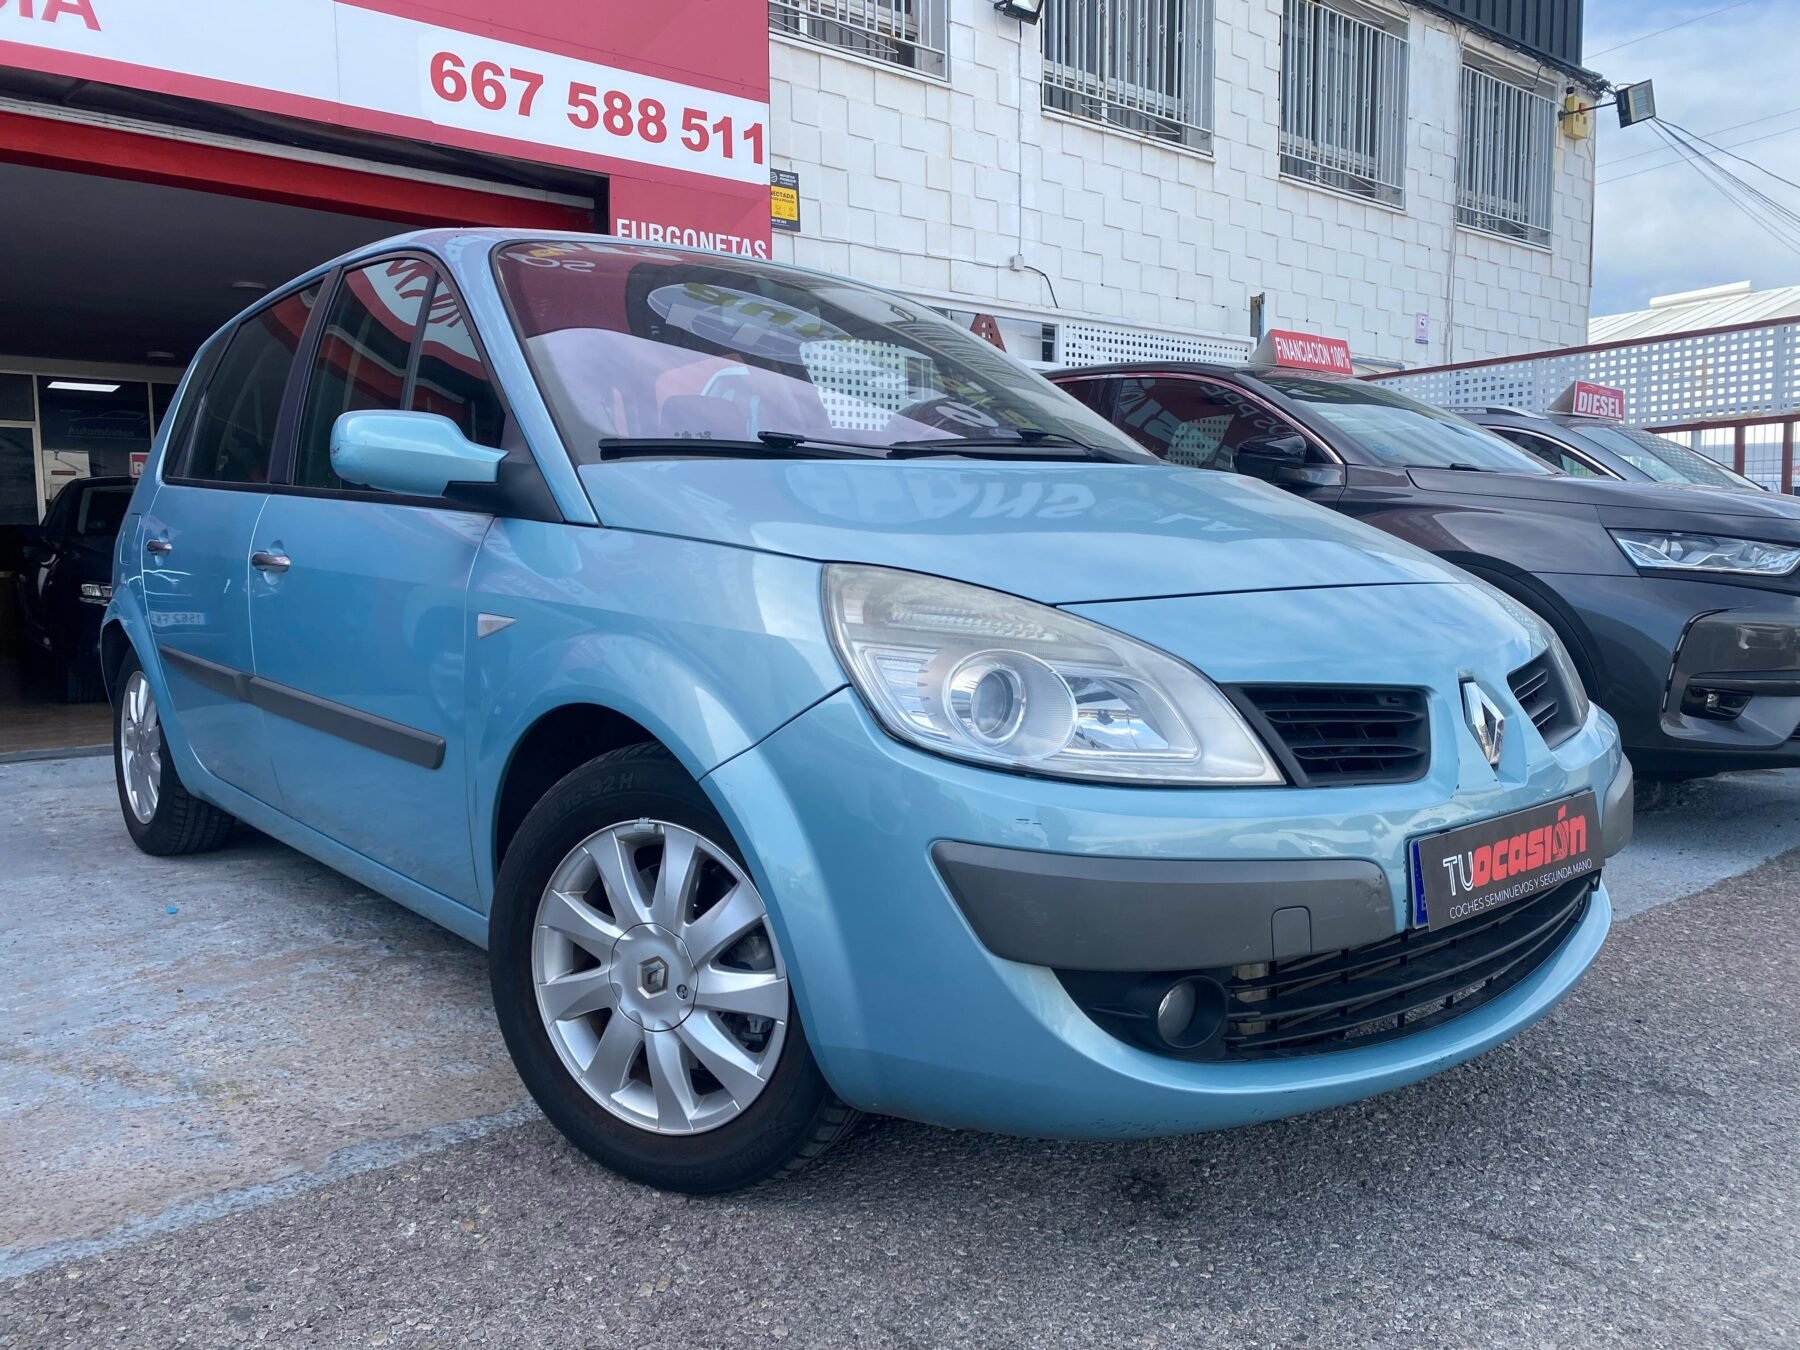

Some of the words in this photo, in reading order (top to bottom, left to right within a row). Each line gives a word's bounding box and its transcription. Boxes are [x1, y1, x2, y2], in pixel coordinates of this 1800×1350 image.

[430, 52, 544, 117] 667
[567, 81, 667, 144] 588
[681, 107, 763, 165] 511
[616, 218, 767, 260] FURGONETAS
[1274, 337, 1332, 366] FINANCIACIÓN
[1330, 345, 1351, 369] 100%
[1577, 391, 1623, 418] DIESEL
[1449, 896, 1485, 920] COCHES
[1484, 878, 1534, 908] SEMINUEVOS
[1533, 877, 1541, 890] Y
[1539, 866, 1573, 887] SEGUNDA
[1572, 858, 1593, 876] MANO
